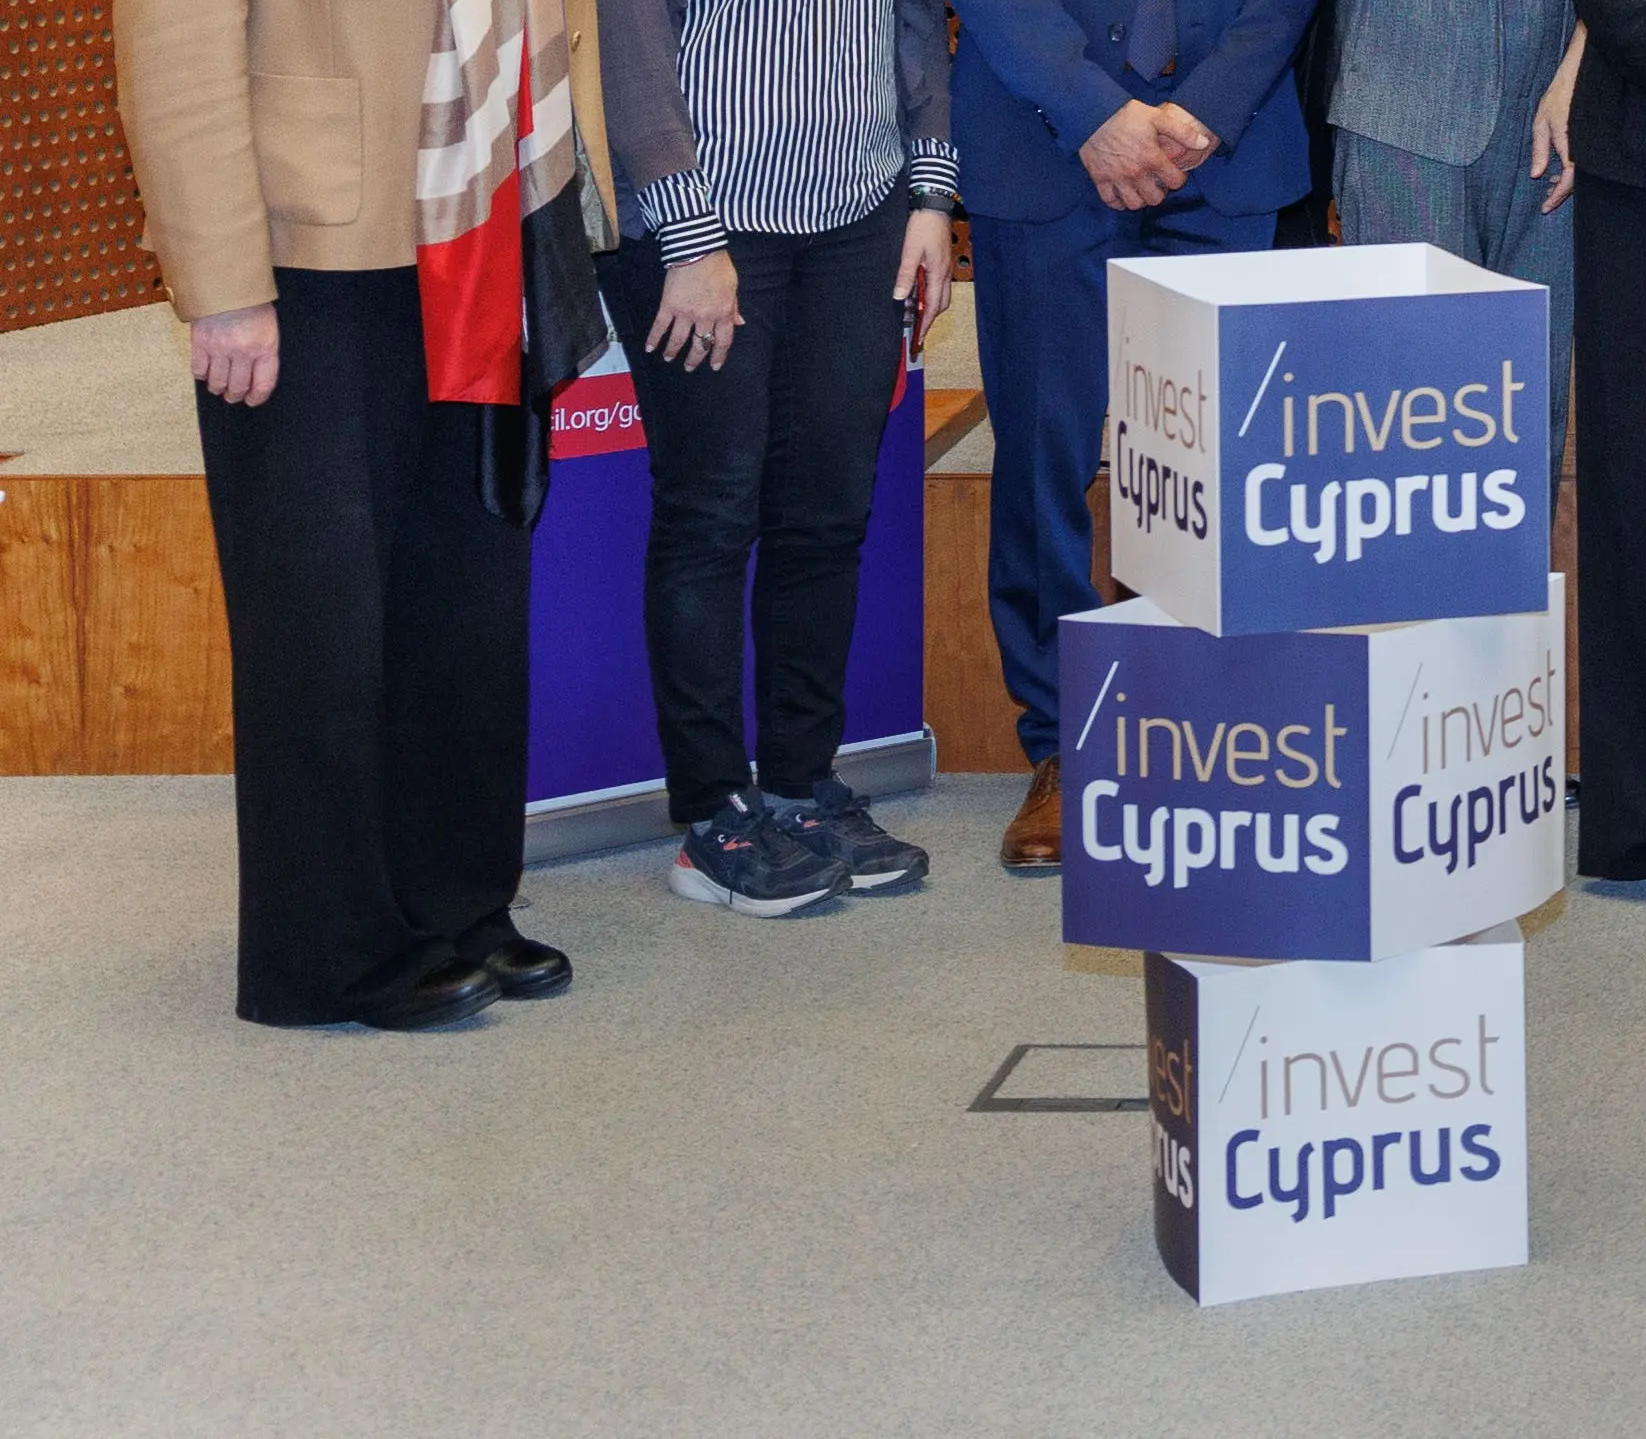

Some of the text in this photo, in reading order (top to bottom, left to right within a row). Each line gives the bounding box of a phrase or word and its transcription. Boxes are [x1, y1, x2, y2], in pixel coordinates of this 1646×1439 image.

[1117, 420, 1208, 540] Cyprus
[1244, 462, 1526, 565] Cyprus
[1081, 779, 1350, 889] Cyprus
[1391, 755, 1557, 875] Cyprus
[1225, 1123, 1502, 1224] Cyprus
